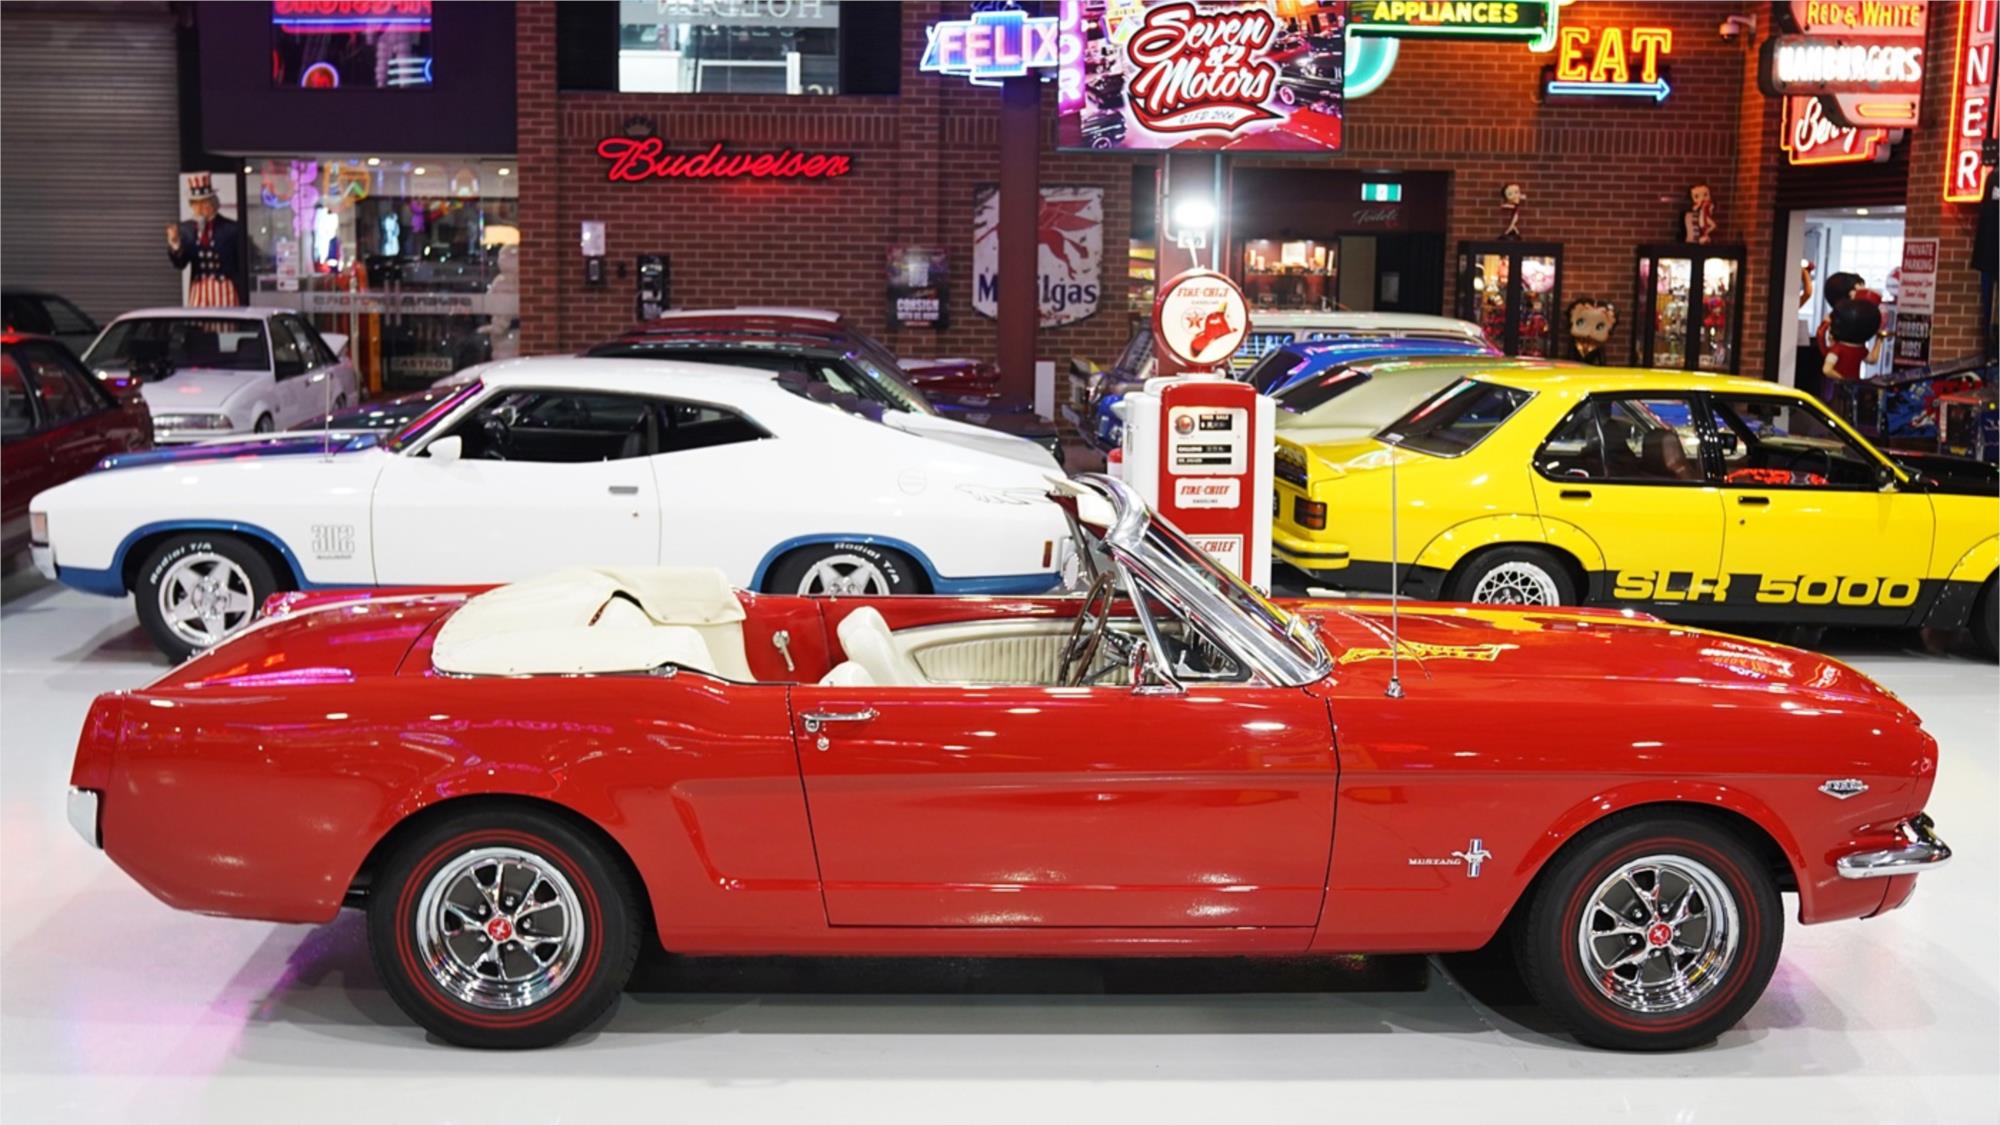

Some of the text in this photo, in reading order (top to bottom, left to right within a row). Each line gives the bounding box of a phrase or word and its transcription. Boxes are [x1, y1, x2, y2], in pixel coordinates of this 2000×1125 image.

[1373, 2, 1519, 24] APPLIANCES
[938, 24, 1058, 66] FELIX
[1132, 10, 1269, 64] Seven
[1557, 26, 1672, 83] EAT
[1205, 45, 1246, 68] 82
[1778, 46, 1922, 82] HAMBURGERS
[1136, 57, 1270, 113] Motors
[597, 137, 850, 181] Budweiser
[1903, 258, 1933, 271] PARKING
[1906, 244, 1935, 256] PRIVATE
[311, 524, 355, 553] 302
[834, 542, 881, 560] Radial
[150, 546, 186, 586] Radial
[1613, 568, 1921, 608] SLR 5000
[1408, 858, 1462, 866] MUSTANG
